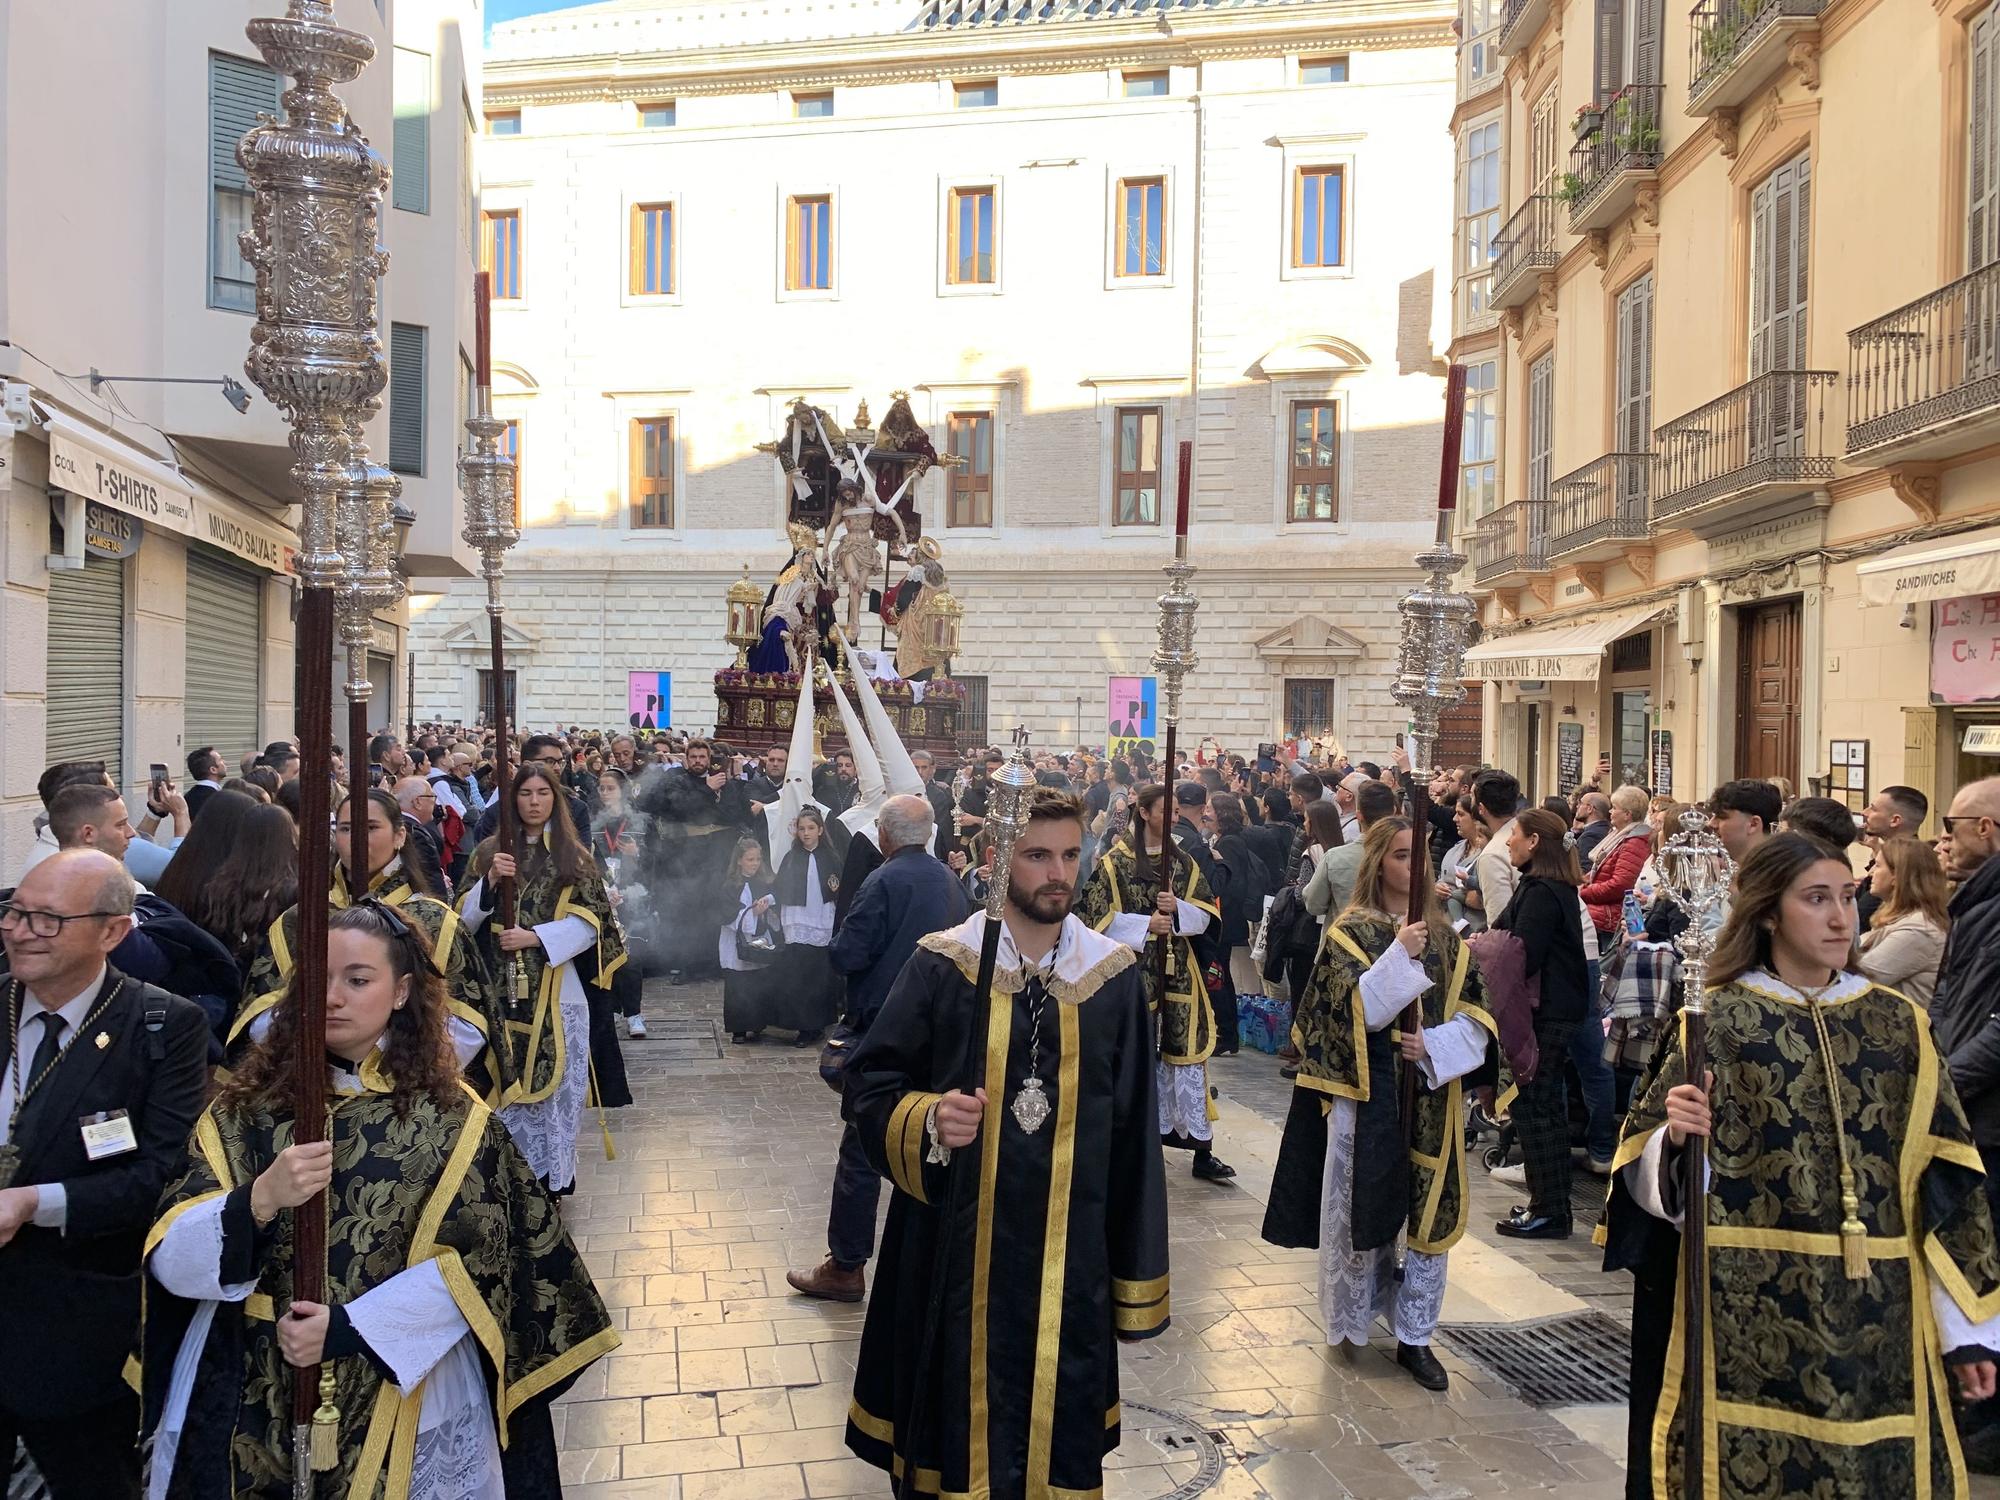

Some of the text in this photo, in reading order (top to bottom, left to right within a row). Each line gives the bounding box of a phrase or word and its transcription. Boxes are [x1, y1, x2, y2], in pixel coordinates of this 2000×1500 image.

[55, 454, 76, 474] COOL
[96, 462, 158, 515] T-SHIRTS
[87, 533, 123, 553] CAMISETAS
[208, 512, 243, 550] MUNDO
[244, 531, 278, 565] SALVAJE
[1896, 570, 1957, 590] SANDWICHES
[1481, 659, 1530, 677] RESTAURANTE
[1537, 658, 1562, 677] TAPAS
[647, 695, 664, 711] PI
[1129, 701, 1148, 719] PI
